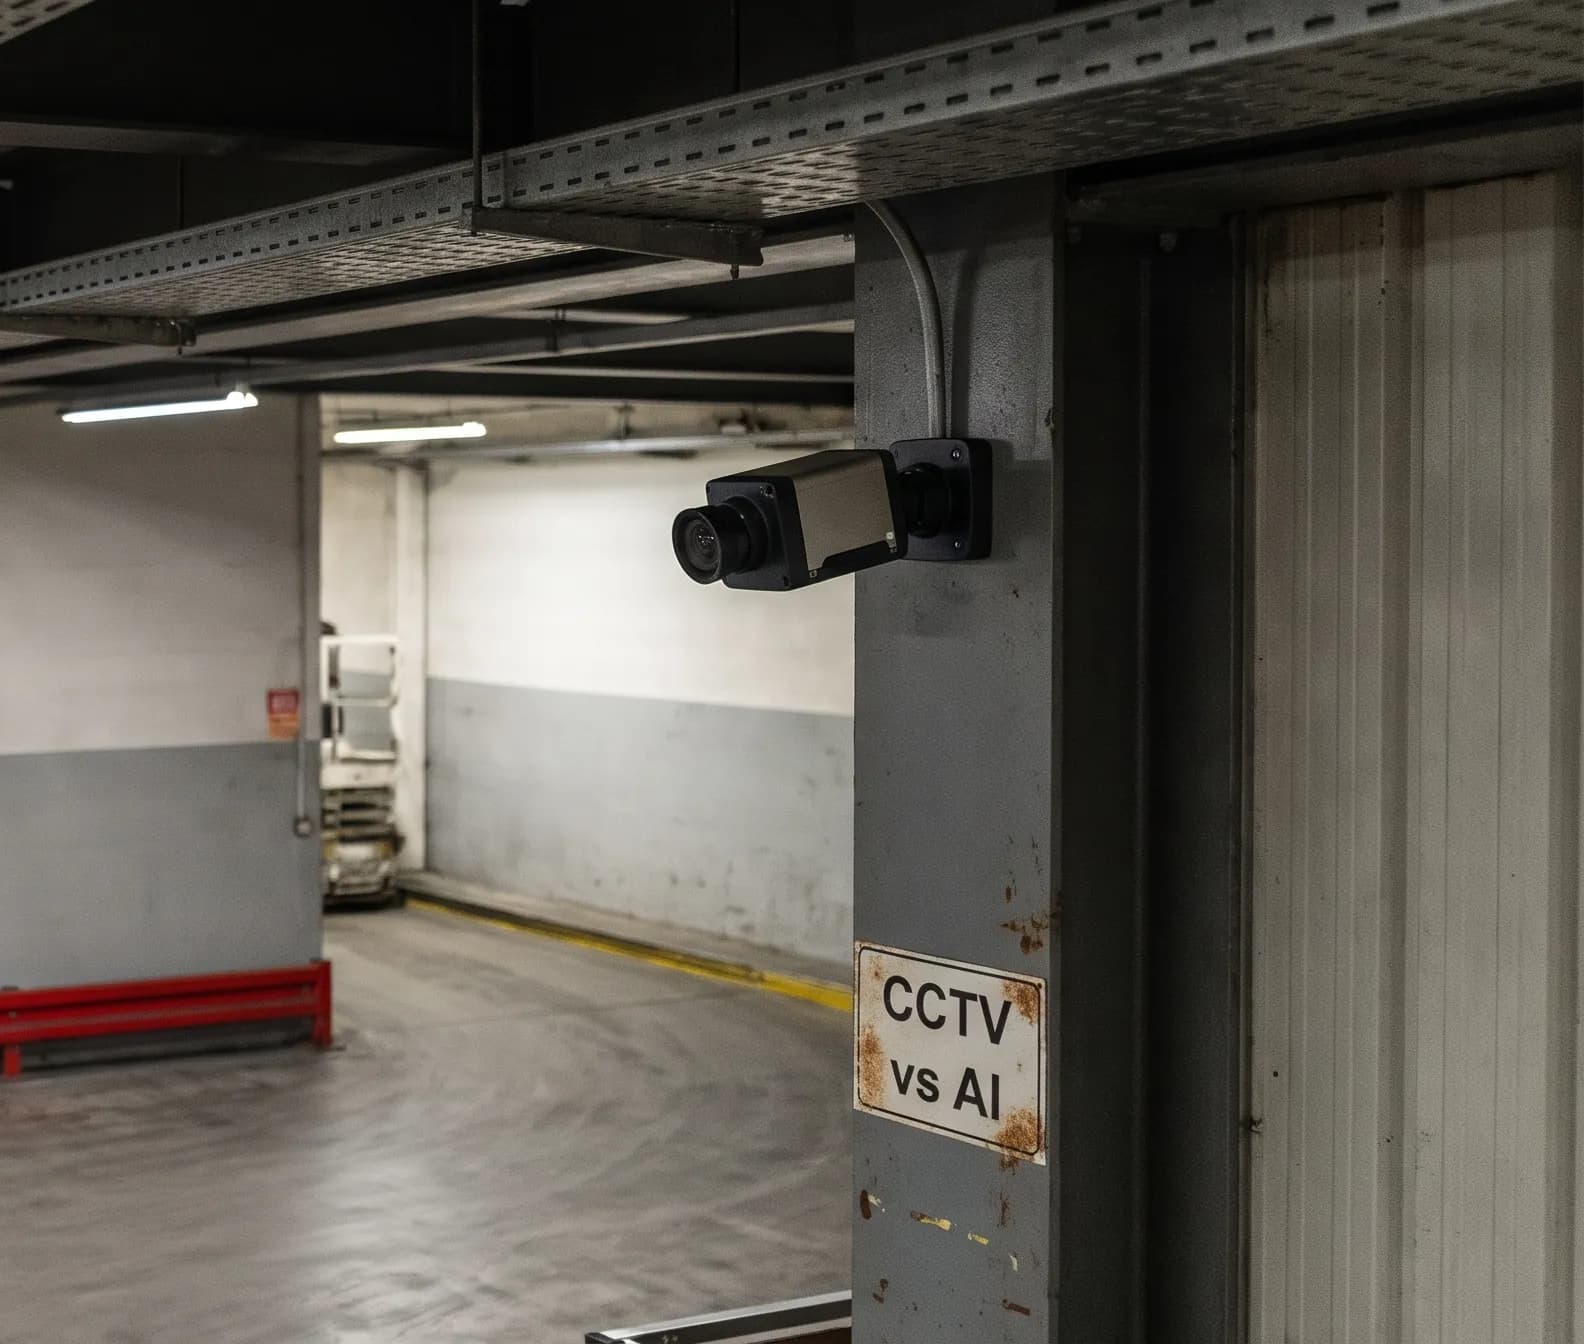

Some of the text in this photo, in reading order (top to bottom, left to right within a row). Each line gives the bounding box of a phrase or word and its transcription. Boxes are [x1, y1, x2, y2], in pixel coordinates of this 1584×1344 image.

[883, 975, 1012, 1045] CCTV
[890, 1059, 1000, 1120] vs AI
